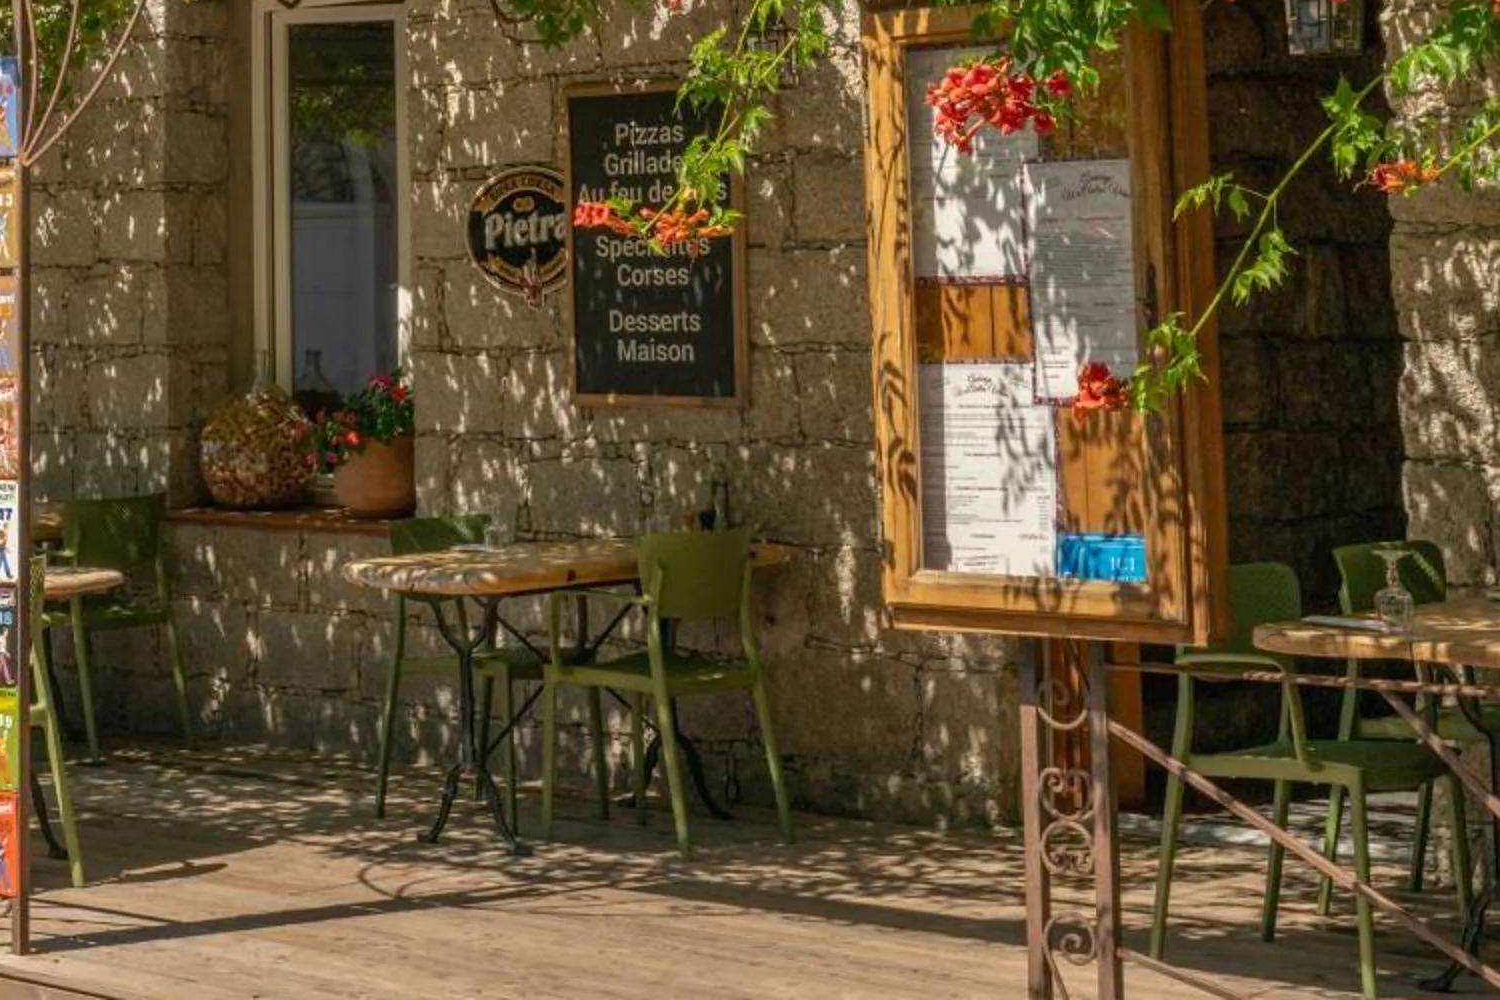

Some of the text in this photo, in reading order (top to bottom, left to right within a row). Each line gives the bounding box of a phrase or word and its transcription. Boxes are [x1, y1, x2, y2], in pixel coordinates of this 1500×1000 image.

[614, 121, 685, 147] Pizzas
[604, 151, 684, 176] Grillade
[578, 184, 605, 203] Au
[648, 179, 675, 204] de
[617, 263, 691, 287] Corses
[609, 309, 702, 333] Desserts
[617, 337, 695, 362] Maison
